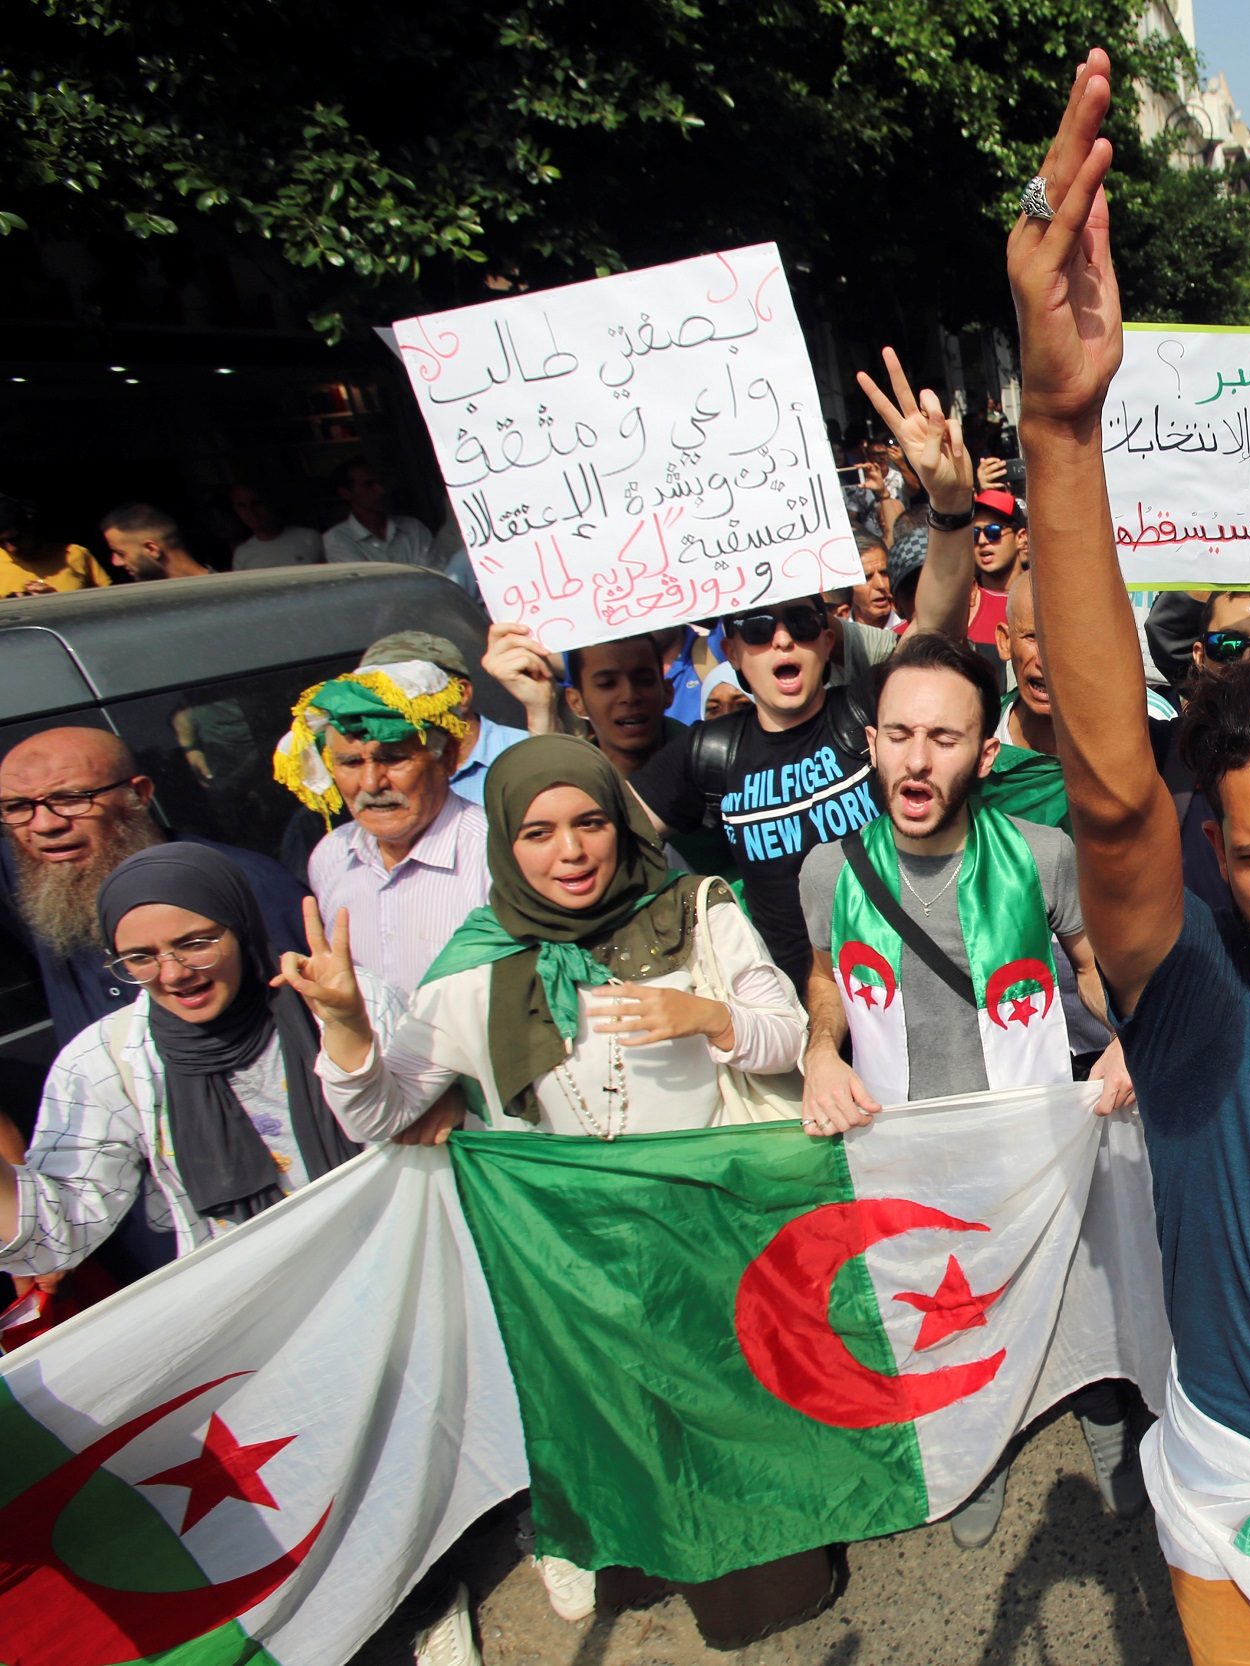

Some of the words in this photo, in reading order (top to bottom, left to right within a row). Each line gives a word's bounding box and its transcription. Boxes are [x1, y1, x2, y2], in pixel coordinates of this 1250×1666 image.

[428, 311, 579, 414] طالب
[599, 298, 759, 399] بصفتي
[600, 406, 647, 477] و
[671, 363, 781, 467] واعي
[678, 474, 831, 571] التعسفية
[743, 816, 802, 861] NEW
[809, 781, 881, 843] YORK
[744, 746, 843, 810] HILFIGER
